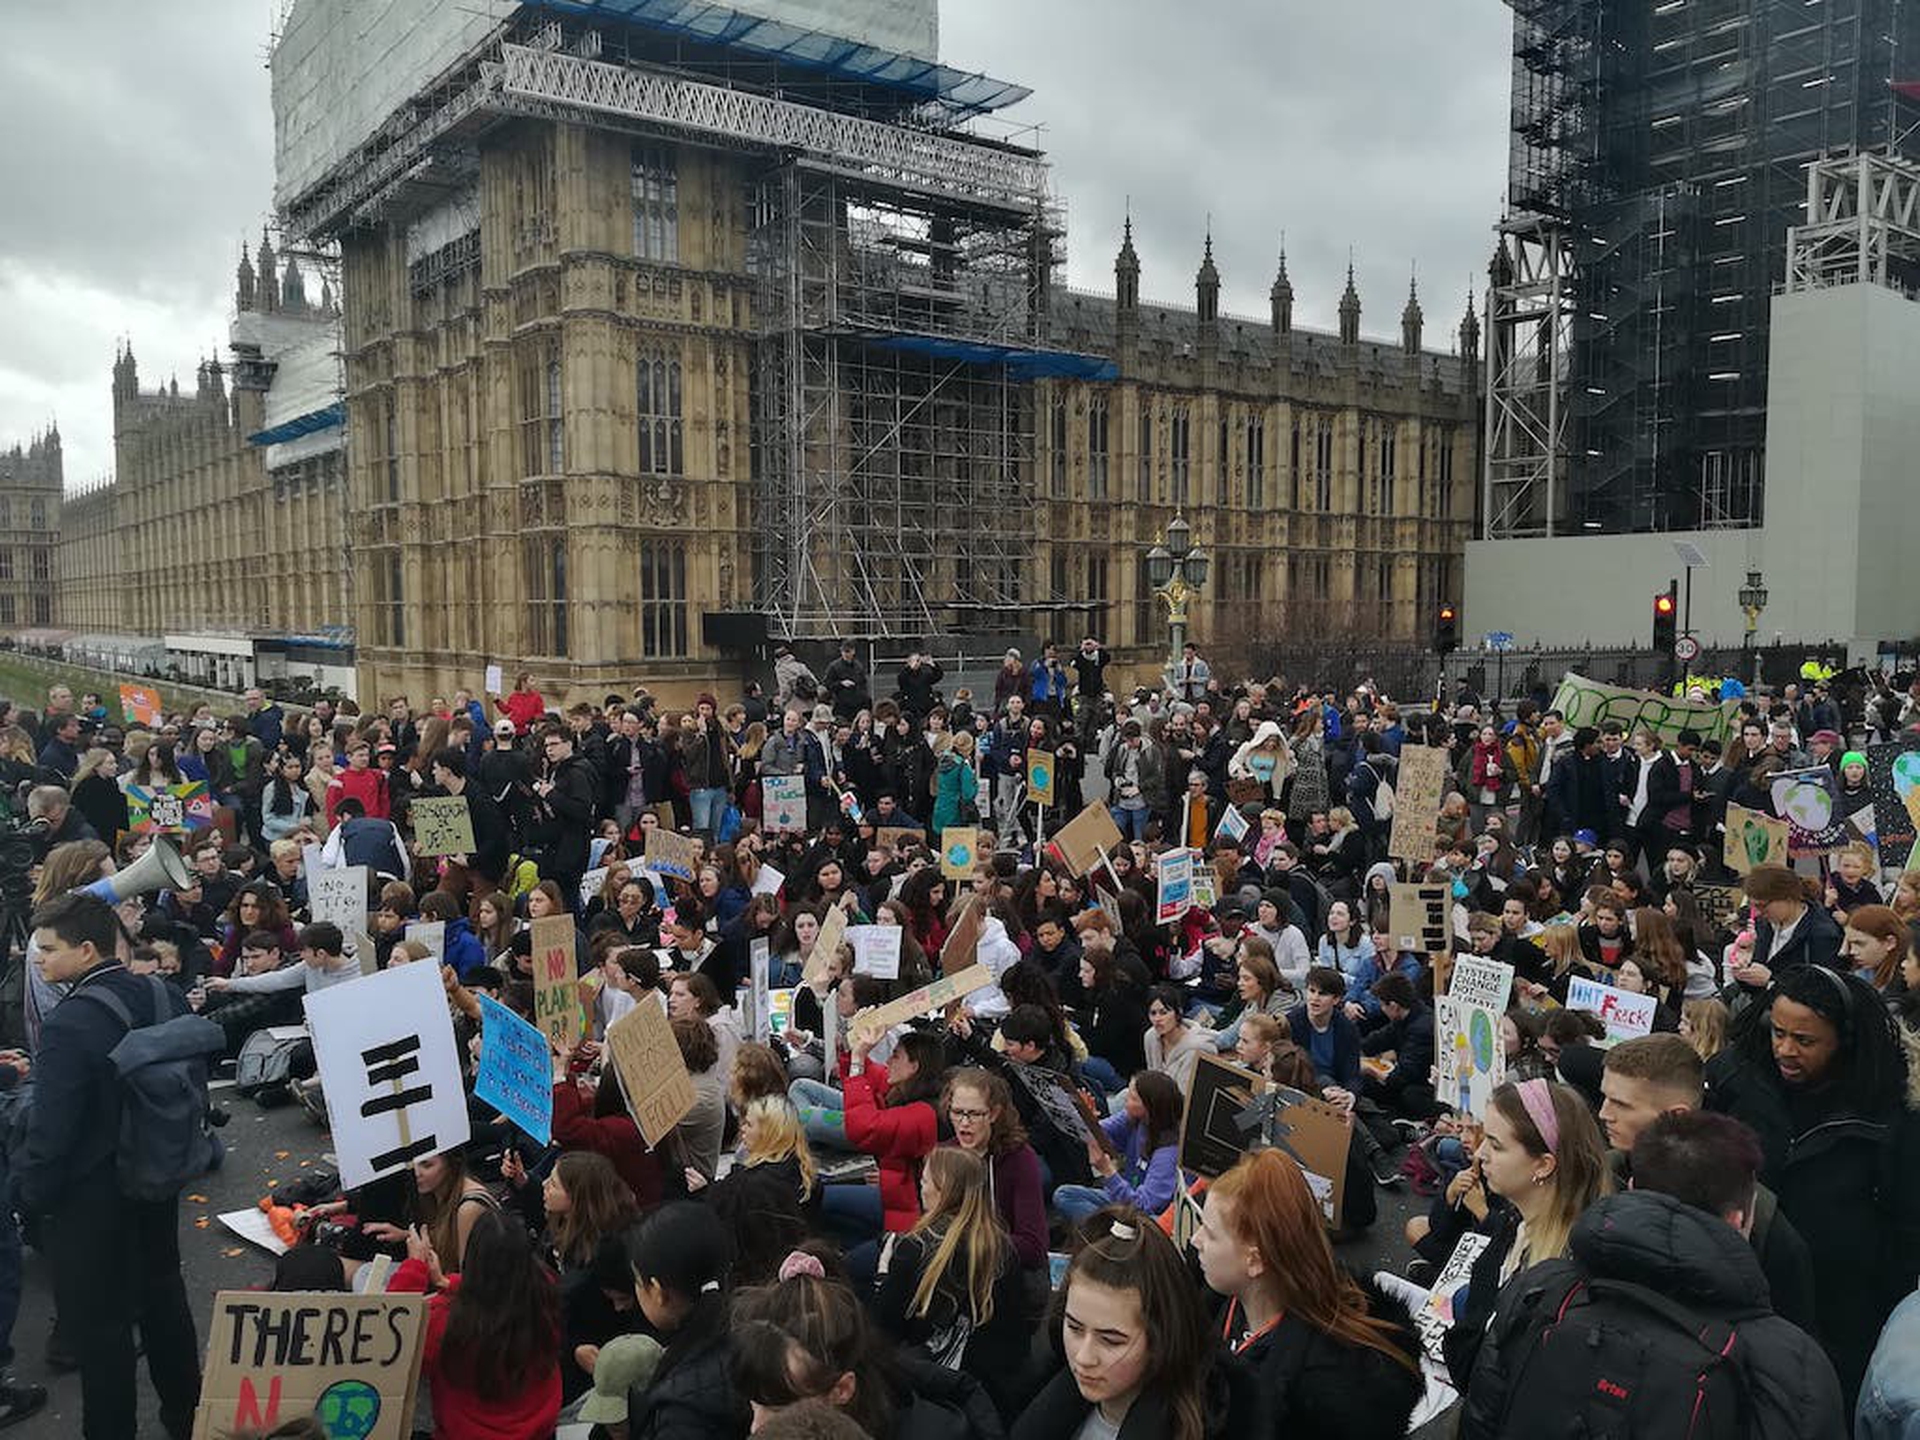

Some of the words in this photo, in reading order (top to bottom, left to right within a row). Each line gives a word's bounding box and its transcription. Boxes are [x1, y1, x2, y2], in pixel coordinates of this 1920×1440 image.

[1677, 643, 1694, 654] 30
[1458, 965, 1501, 983] SYSTEM
[1453, 983, 1475, 996] NOT
[1455, 974, 1501, 994] CHANGE
[1452, 993, 1497, 1010] LIMATE
[225, 1302, 410, 1368] THERE'S
